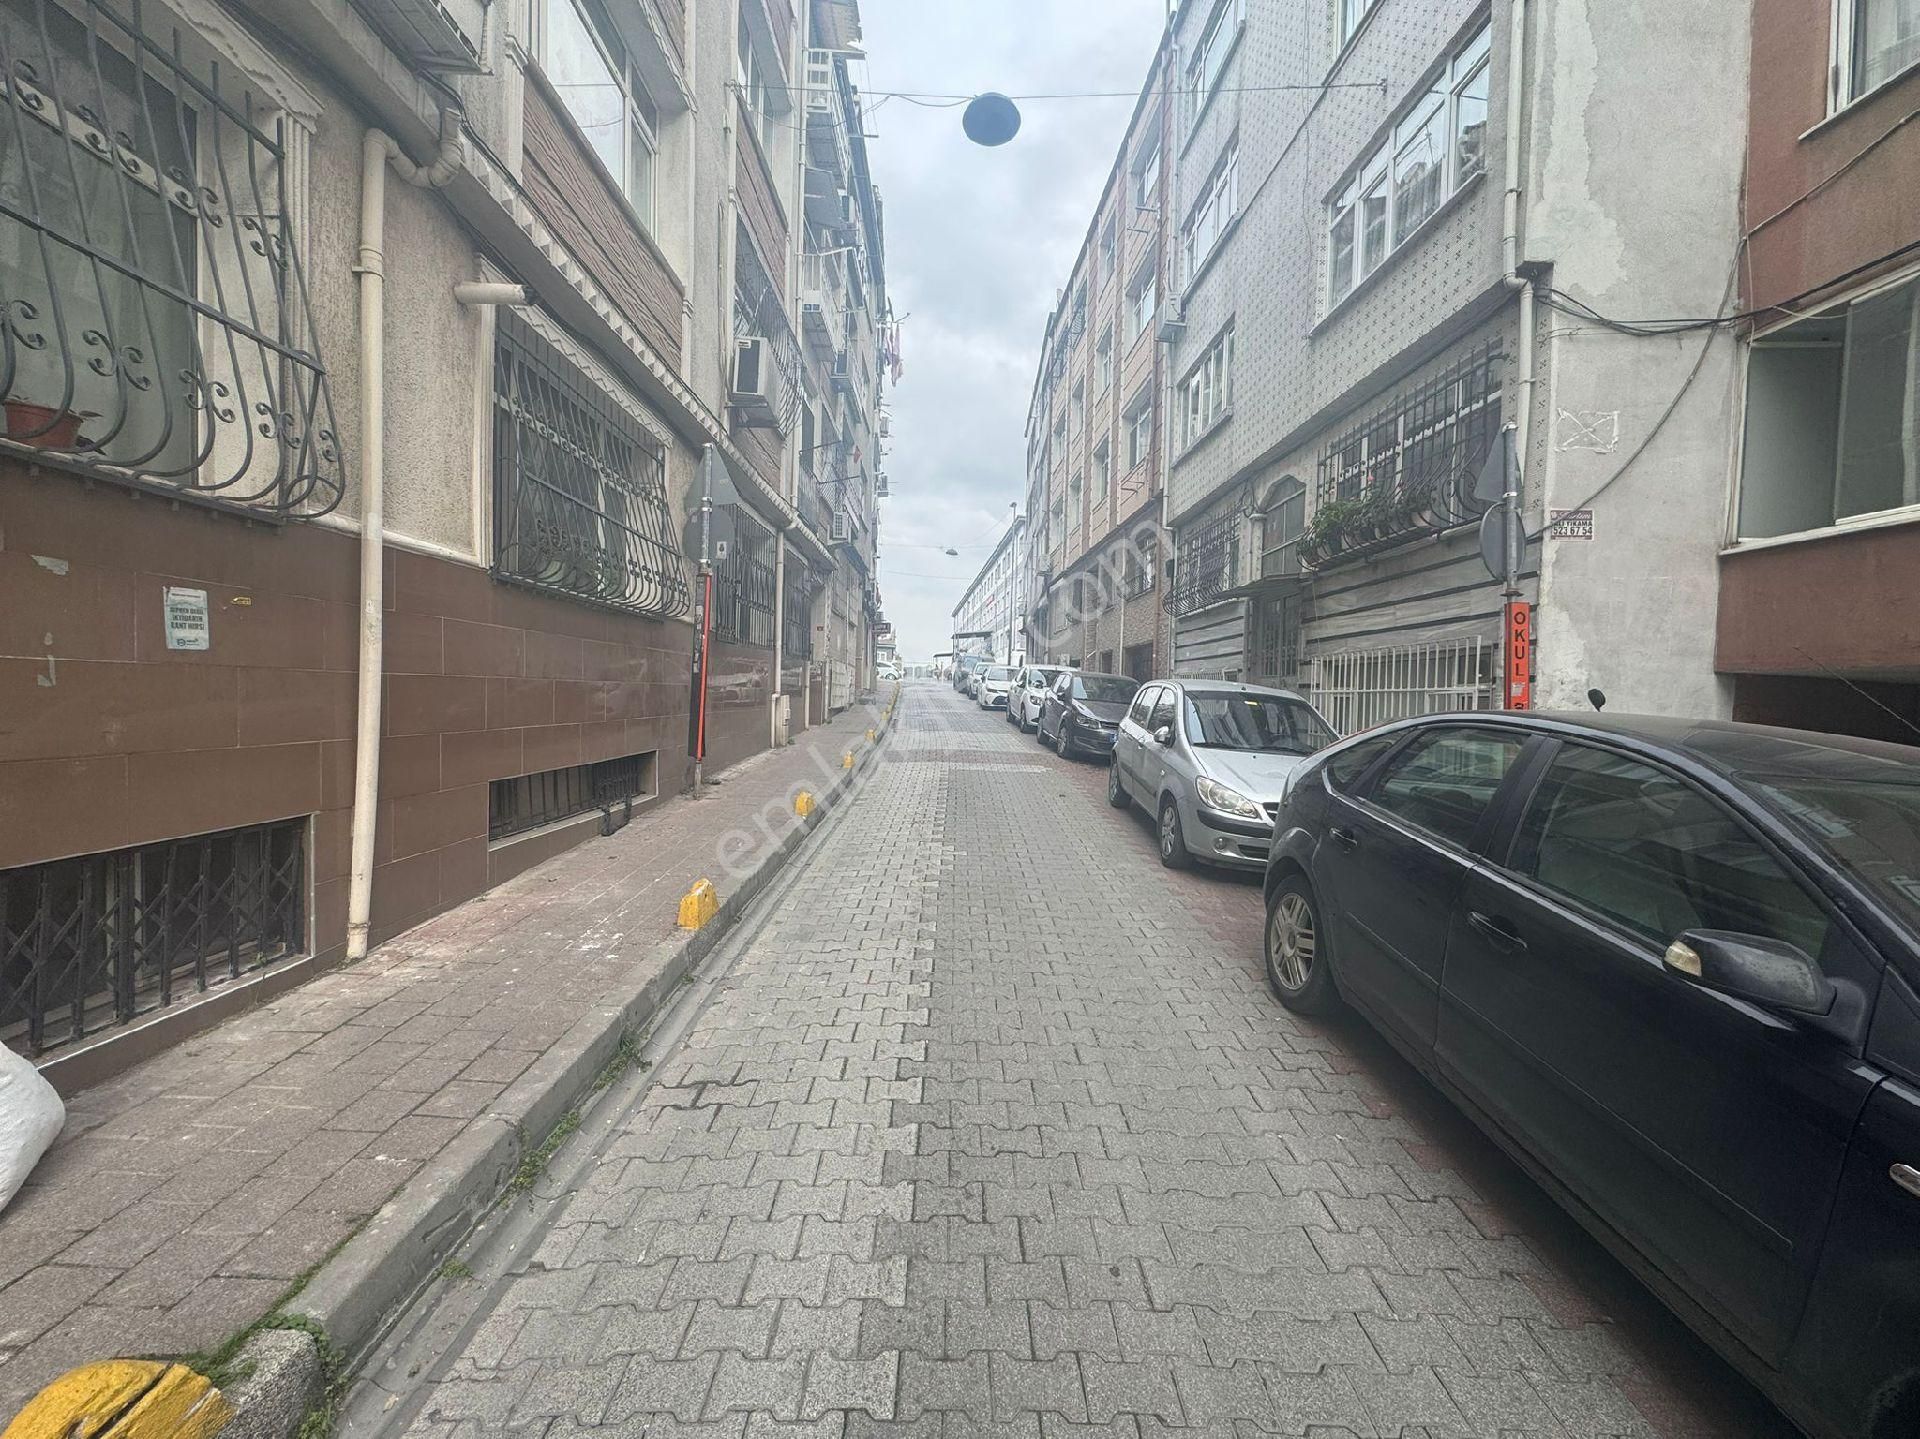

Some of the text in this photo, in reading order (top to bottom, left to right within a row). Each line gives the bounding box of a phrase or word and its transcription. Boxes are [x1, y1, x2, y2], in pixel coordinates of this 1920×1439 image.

[1553, 526, 1593, 535] 523 67 54
[1514, 611, 1526, 677] OKUL
